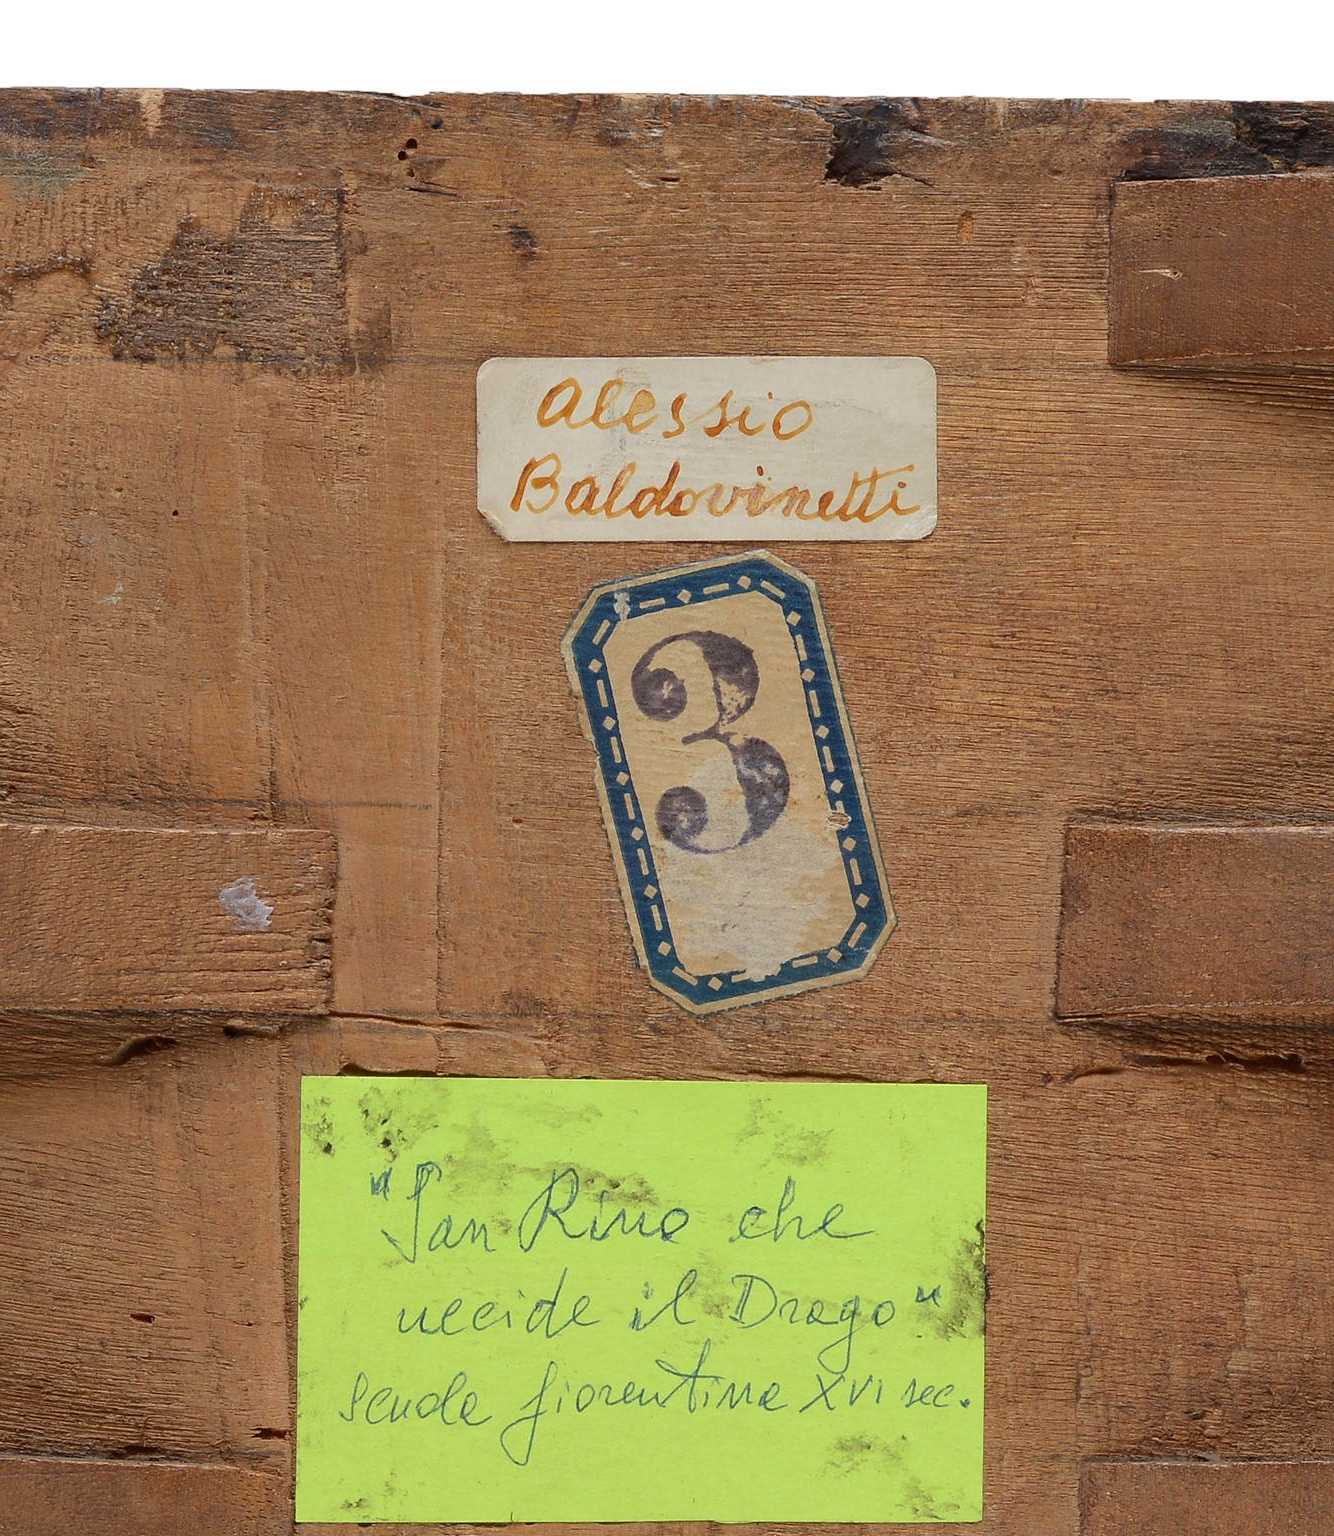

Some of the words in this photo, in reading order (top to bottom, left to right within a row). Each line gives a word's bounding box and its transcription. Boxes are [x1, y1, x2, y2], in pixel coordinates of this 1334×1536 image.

[509, 452, 922, 524] Baldovinetti
[630, 630, 790, 855] 3
[728, 1175, 876, 1242] che
[397, 1266, 601, 1339] uccide
[628, 1268, 698, 1332] il
[901, 1378, 971, 1409] sec.
